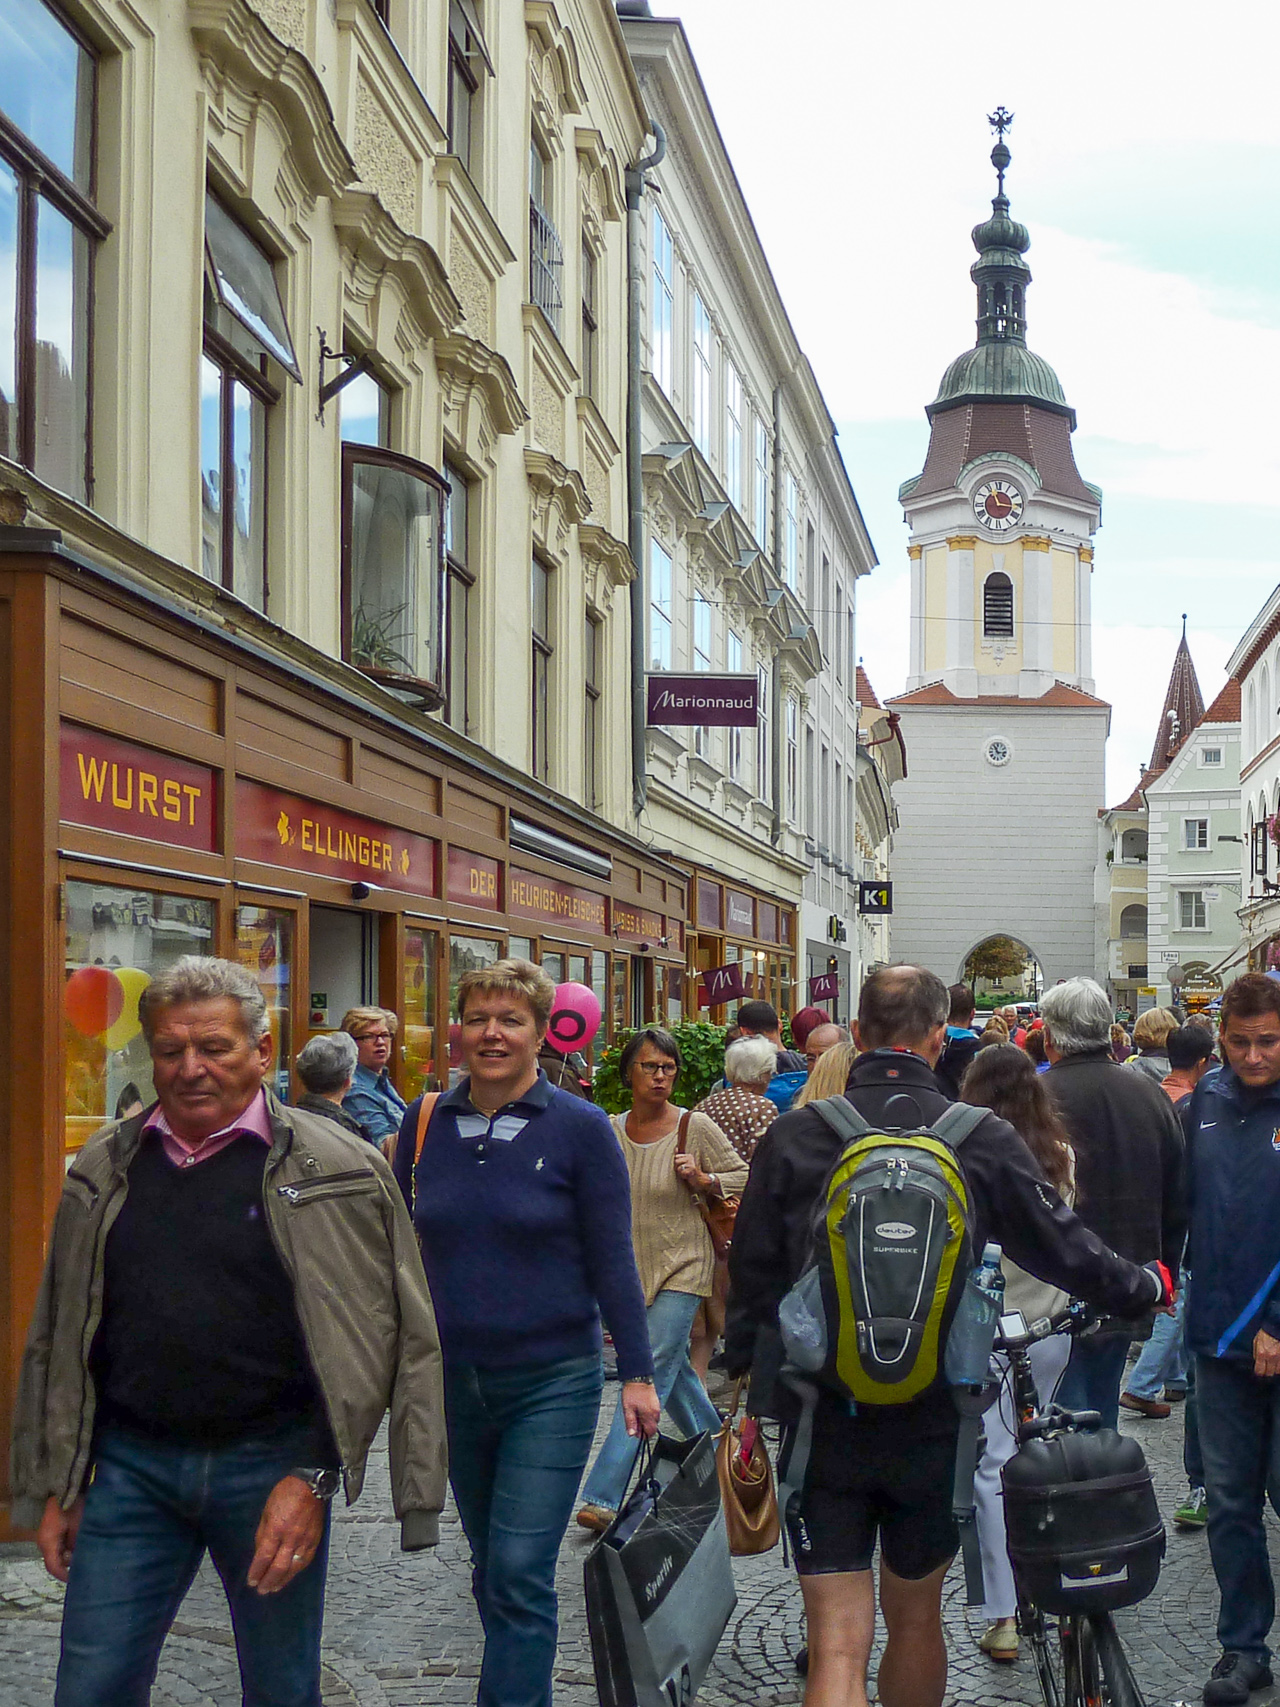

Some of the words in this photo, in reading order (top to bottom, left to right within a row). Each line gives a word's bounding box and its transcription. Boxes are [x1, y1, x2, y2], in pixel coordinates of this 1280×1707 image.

[652, 690, 754, 712] Marionnaud
[76, 752, 202, 827] WURST
[301, 817, 394, 873] ELLINGER
[469, 867, 497, 900] DER
[863, 889, 888, 907] K1
[877, 1227, 914, 1235] deuter
[873, 1246, 918, 1254] SUPERBIKE
